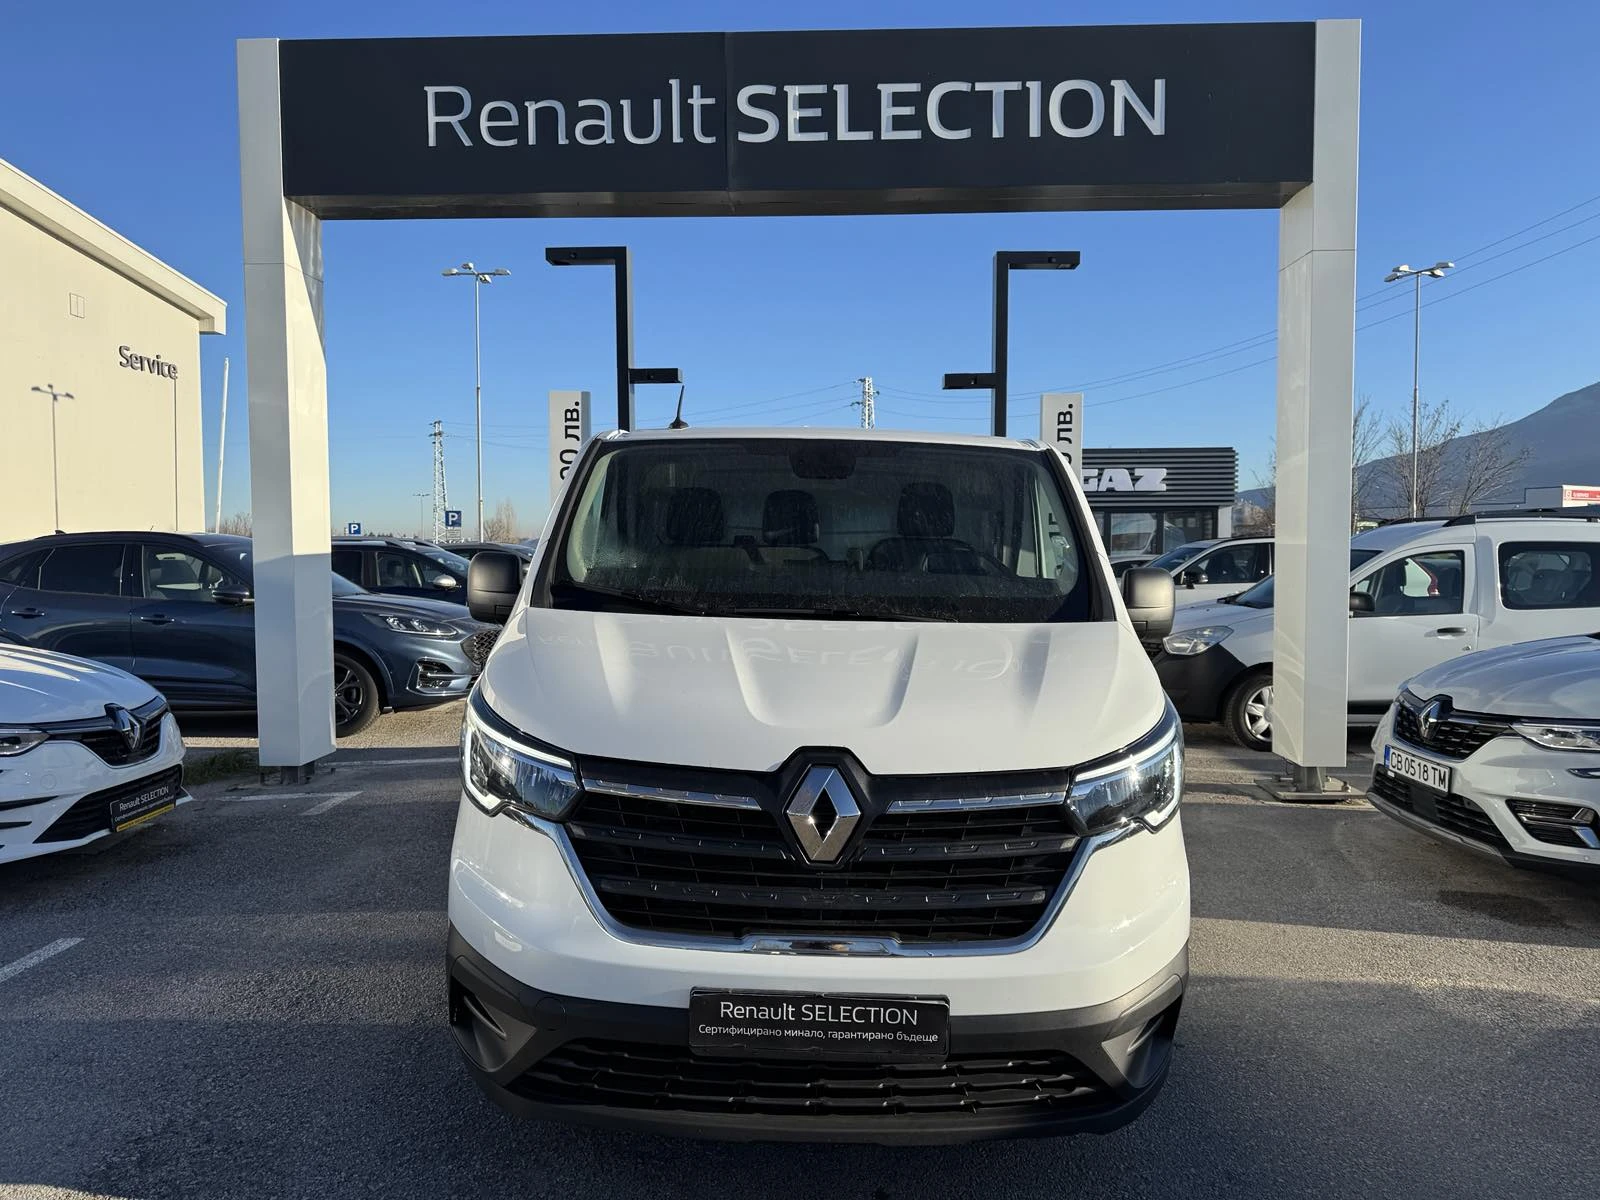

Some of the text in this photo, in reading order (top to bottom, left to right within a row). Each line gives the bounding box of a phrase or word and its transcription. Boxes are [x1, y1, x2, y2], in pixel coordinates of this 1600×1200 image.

[423, 78, 1167, 148] Renault SELECTION
[118, 345, 178, 380] Service
[350, 524, 358, 533] P
[448, 512, 458, 525] P
[1404, 757, 1429, 781] 0518
[119, 797, 140, 812] Renault
[140, 785, 169, 804] SELECTION
[720, 1001, 918, 1026] Renault SELECTION
[698, 1024, 938, 1042] Сертифицирано минало, гарантирано бъдеще
